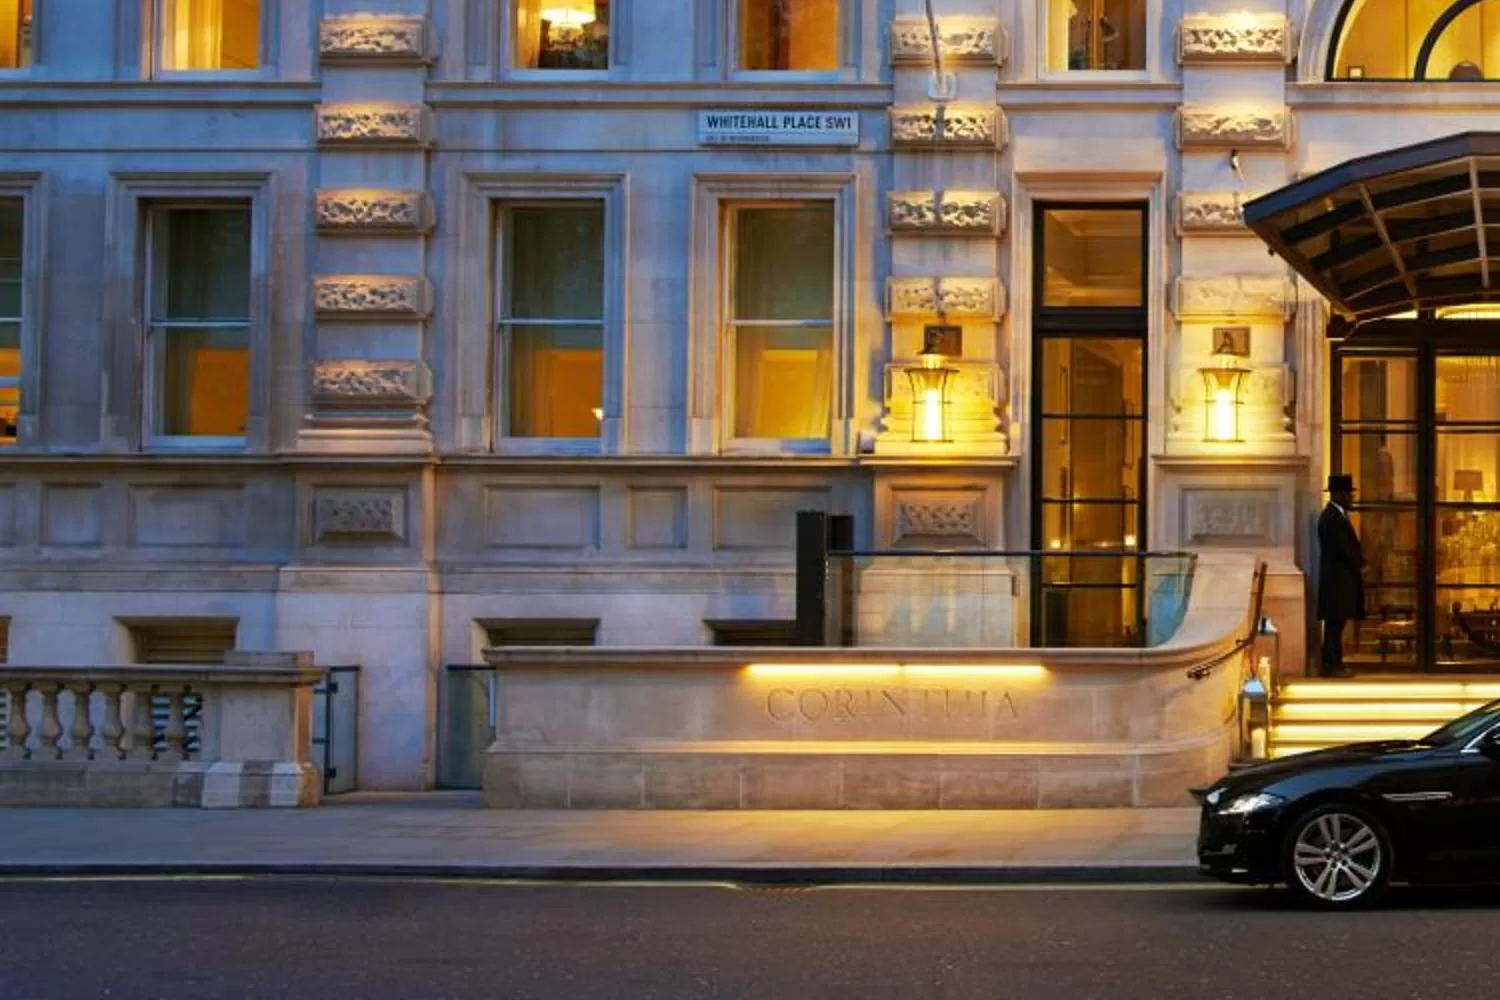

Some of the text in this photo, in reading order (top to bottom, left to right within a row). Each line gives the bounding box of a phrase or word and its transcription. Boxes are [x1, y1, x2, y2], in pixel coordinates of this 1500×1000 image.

[706, 115, 851, 129] WHITEHALL PLACE SW1
[766, 687, 1019, 721] CORINTHIA
